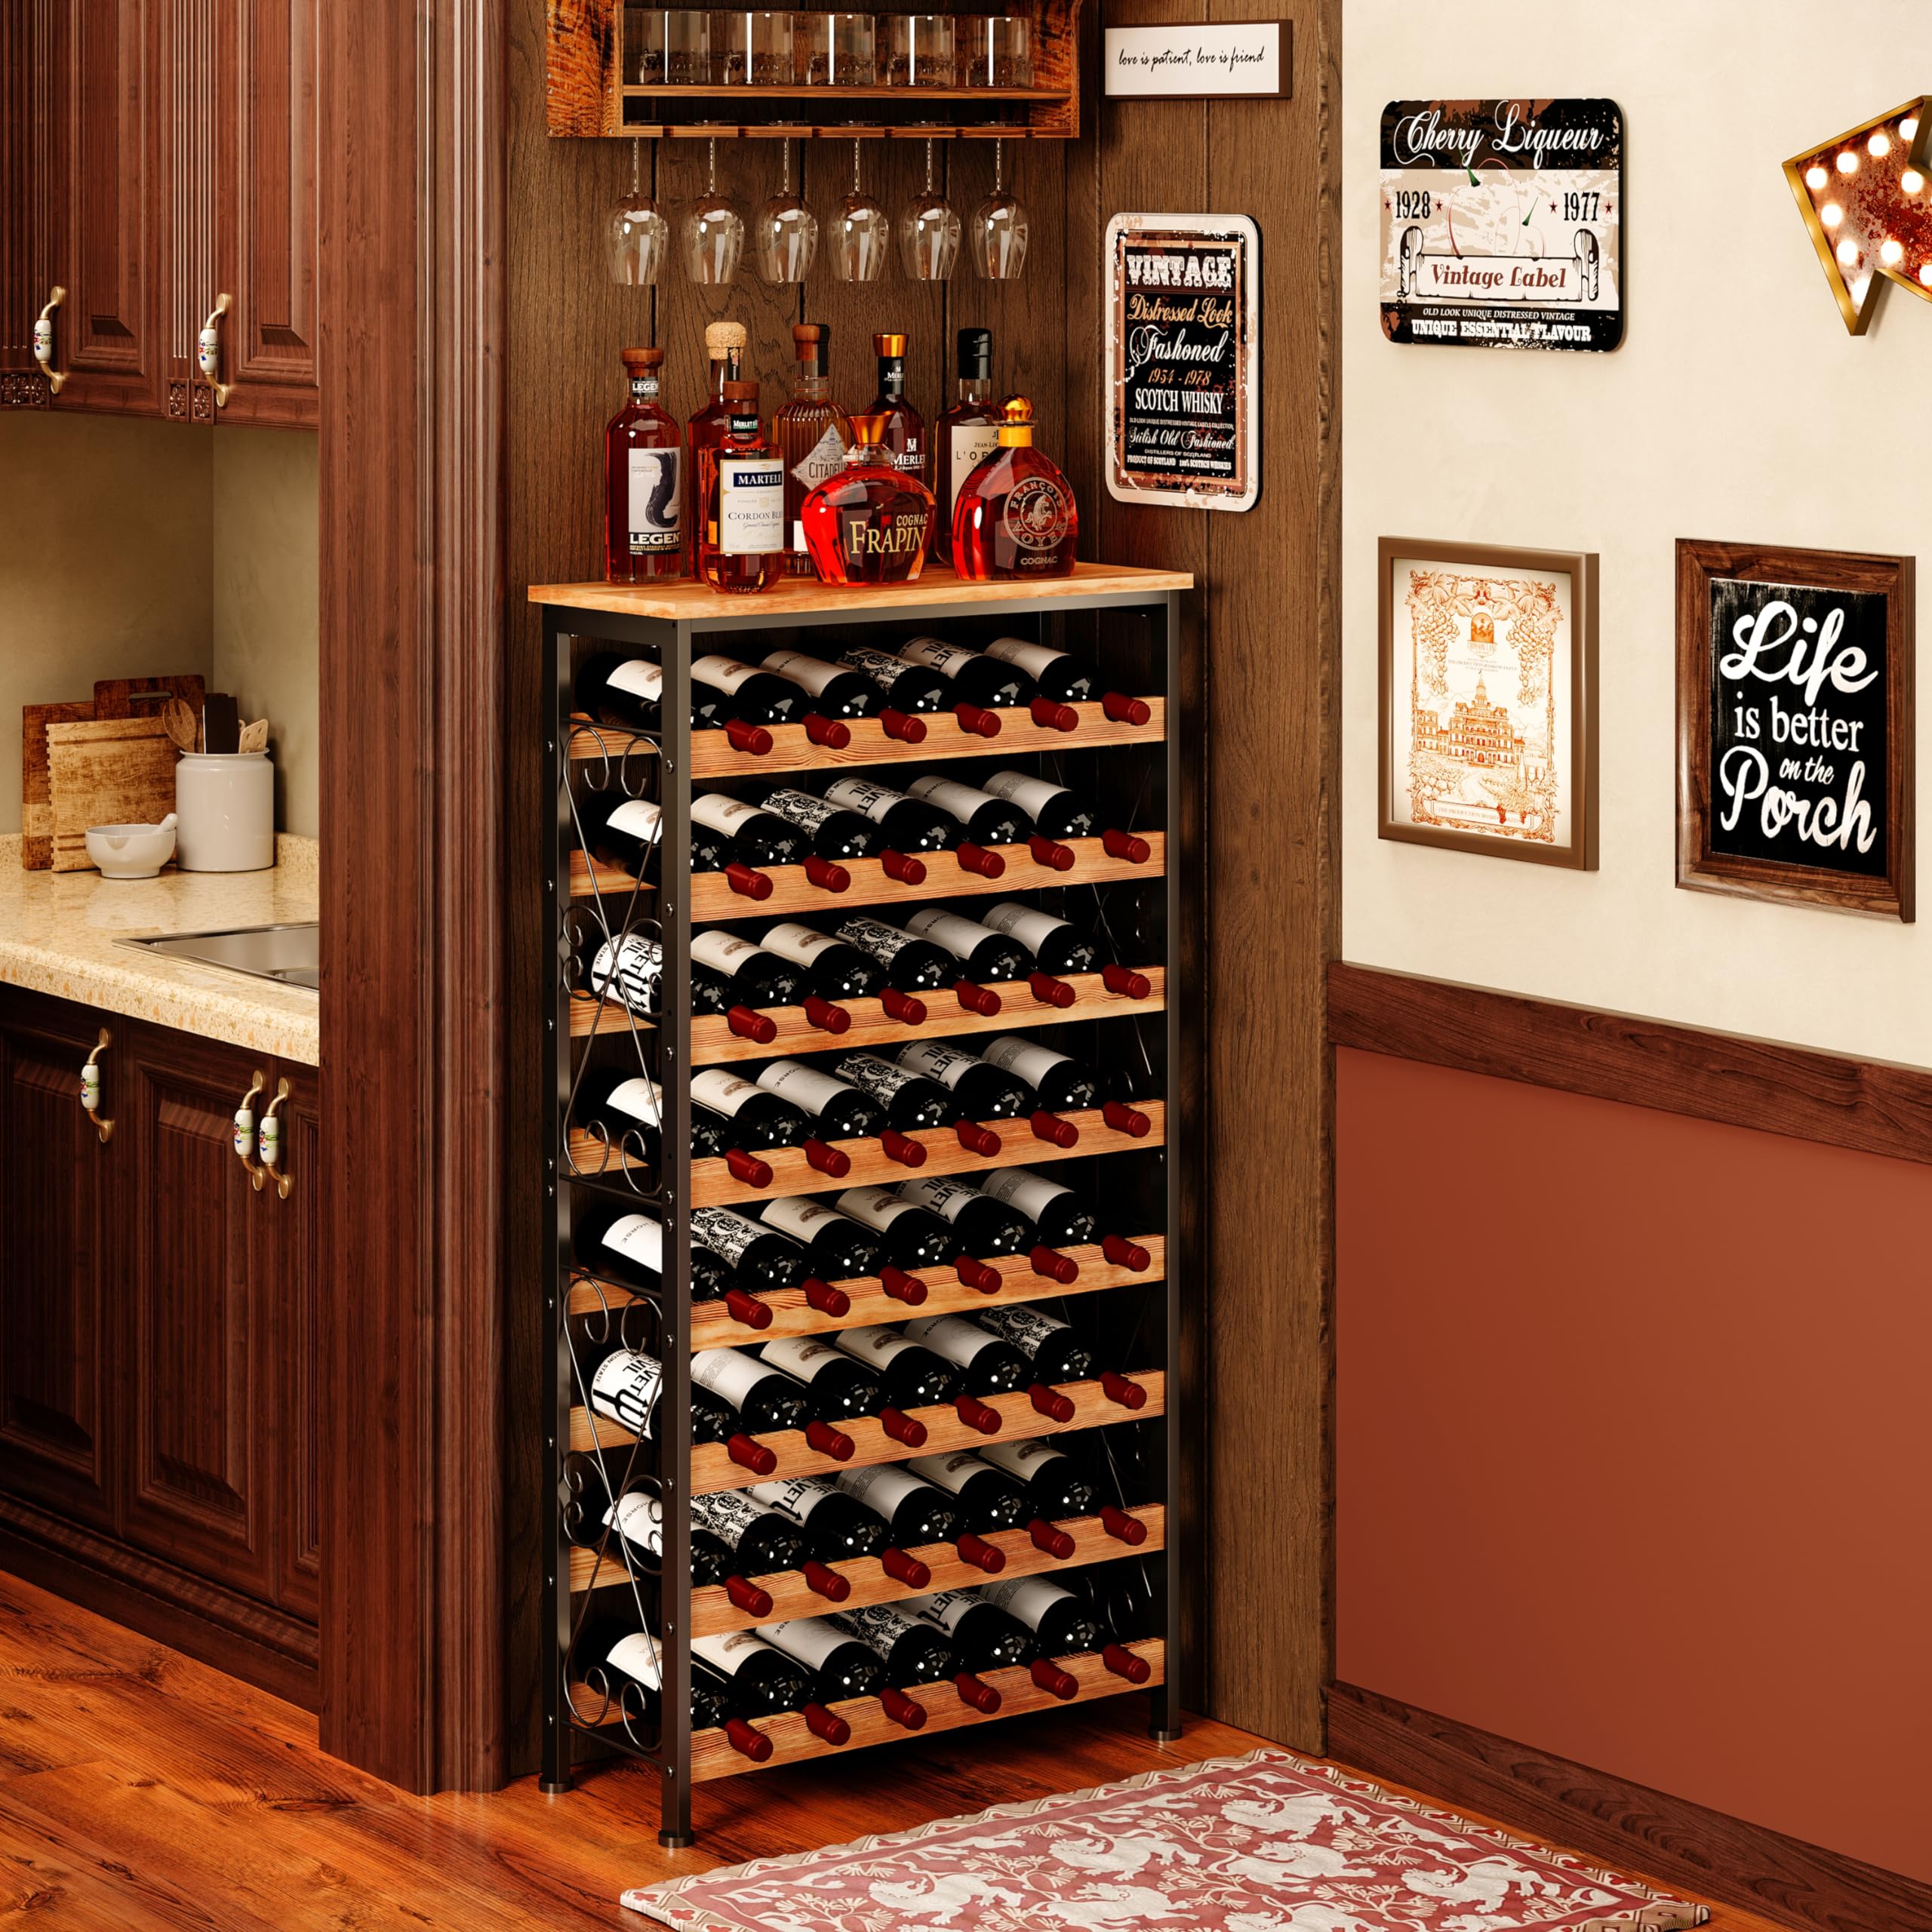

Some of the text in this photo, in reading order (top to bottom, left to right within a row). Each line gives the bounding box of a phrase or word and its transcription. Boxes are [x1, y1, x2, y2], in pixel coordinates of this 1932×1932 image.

[1118, 45, 1265, 72] love is patient, love is friend
[1394, 100, 1604, 170] Cherry Liqueur
[1395, 191, 1432, 219] 1928
[1564, 192, 1600, 221] 1977
[1126, 254, 1232, 288] VINTAGE
[1432, 264, 1567, 289] Vintage Label
[1127, 294, 1233, 328] Distressed Look
[1423, 308, 1576, 321] OLD LOOK UNIQUE DISTRESSED VINTAGE
[1411, 319, 1592, 342] UNIQUE ESSENTIAL FLAVOUR
[1183, 369, 1212, 386] 1978
[1135, 387, 1223, 414] SCOTCH WHISKY
[1160, 429, 1181, 446] Old
[1144, 448, 1174, 457] DISTILLERS
[728, 512, 771, 521] CORDON
[896, 513, 929, 527] COGNAC
[629, 532, 681, 545] LEGEN
[849, 521, 928, 554] FRAPIN
[1011, 521, 1066, 547] VOYER
[1020, 555, 1059, 565] COGNAC
[1720, 601, 1878, 707] Life
[1734, 691, 1864, 752] is better
[1779, 755, 1835, 785] on the
[1720, 745, 1878, 854] Porch
